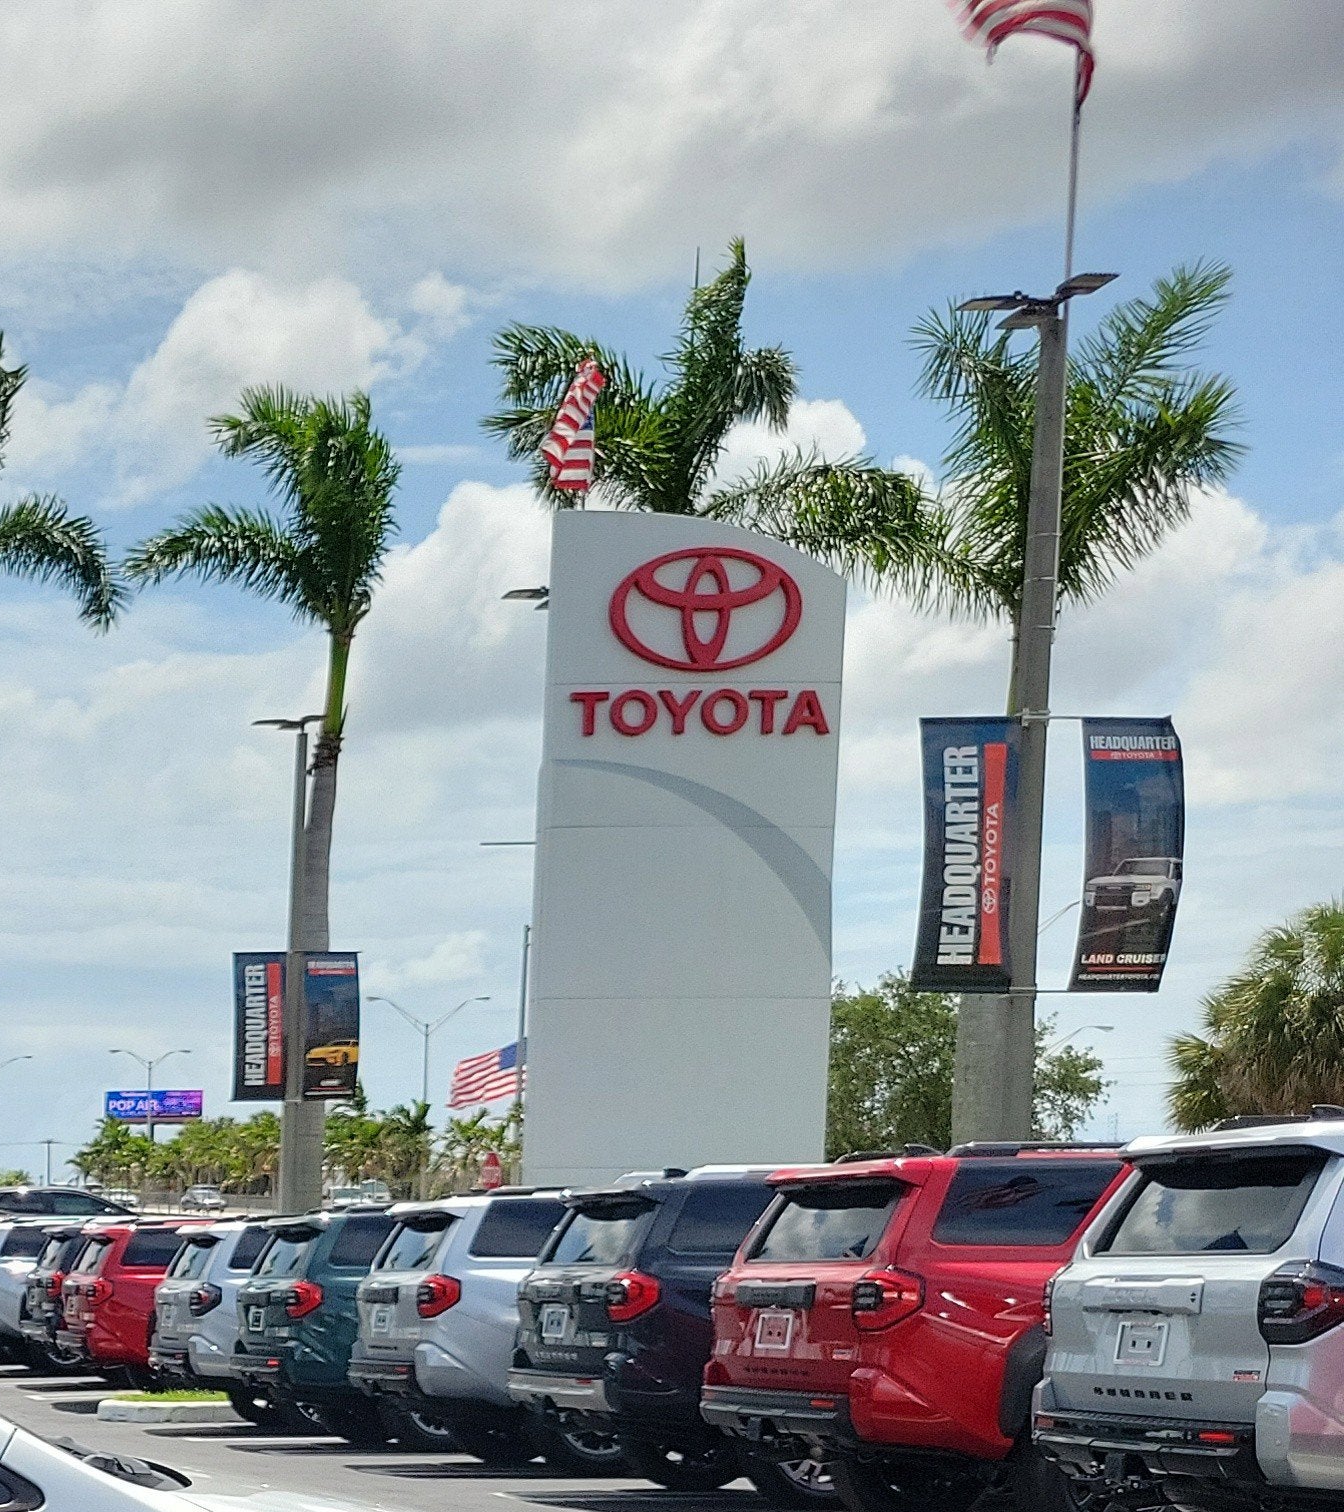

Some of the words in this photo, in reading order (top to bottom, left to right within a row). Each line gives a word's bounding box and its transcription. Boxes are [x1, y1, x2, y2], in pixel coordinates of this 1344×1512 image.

[570, 689, 830, 736] TOYOTA
[1089, 735, 1176, 751] HEADQUARTER
[936, 745, 981, 966] HEADQUARTER
[983, 803, 1000, 882] TOYOTA
[1081, 954, 1114, 964] LAND
[244, 964, 267, 1086] HEADQUARTER
